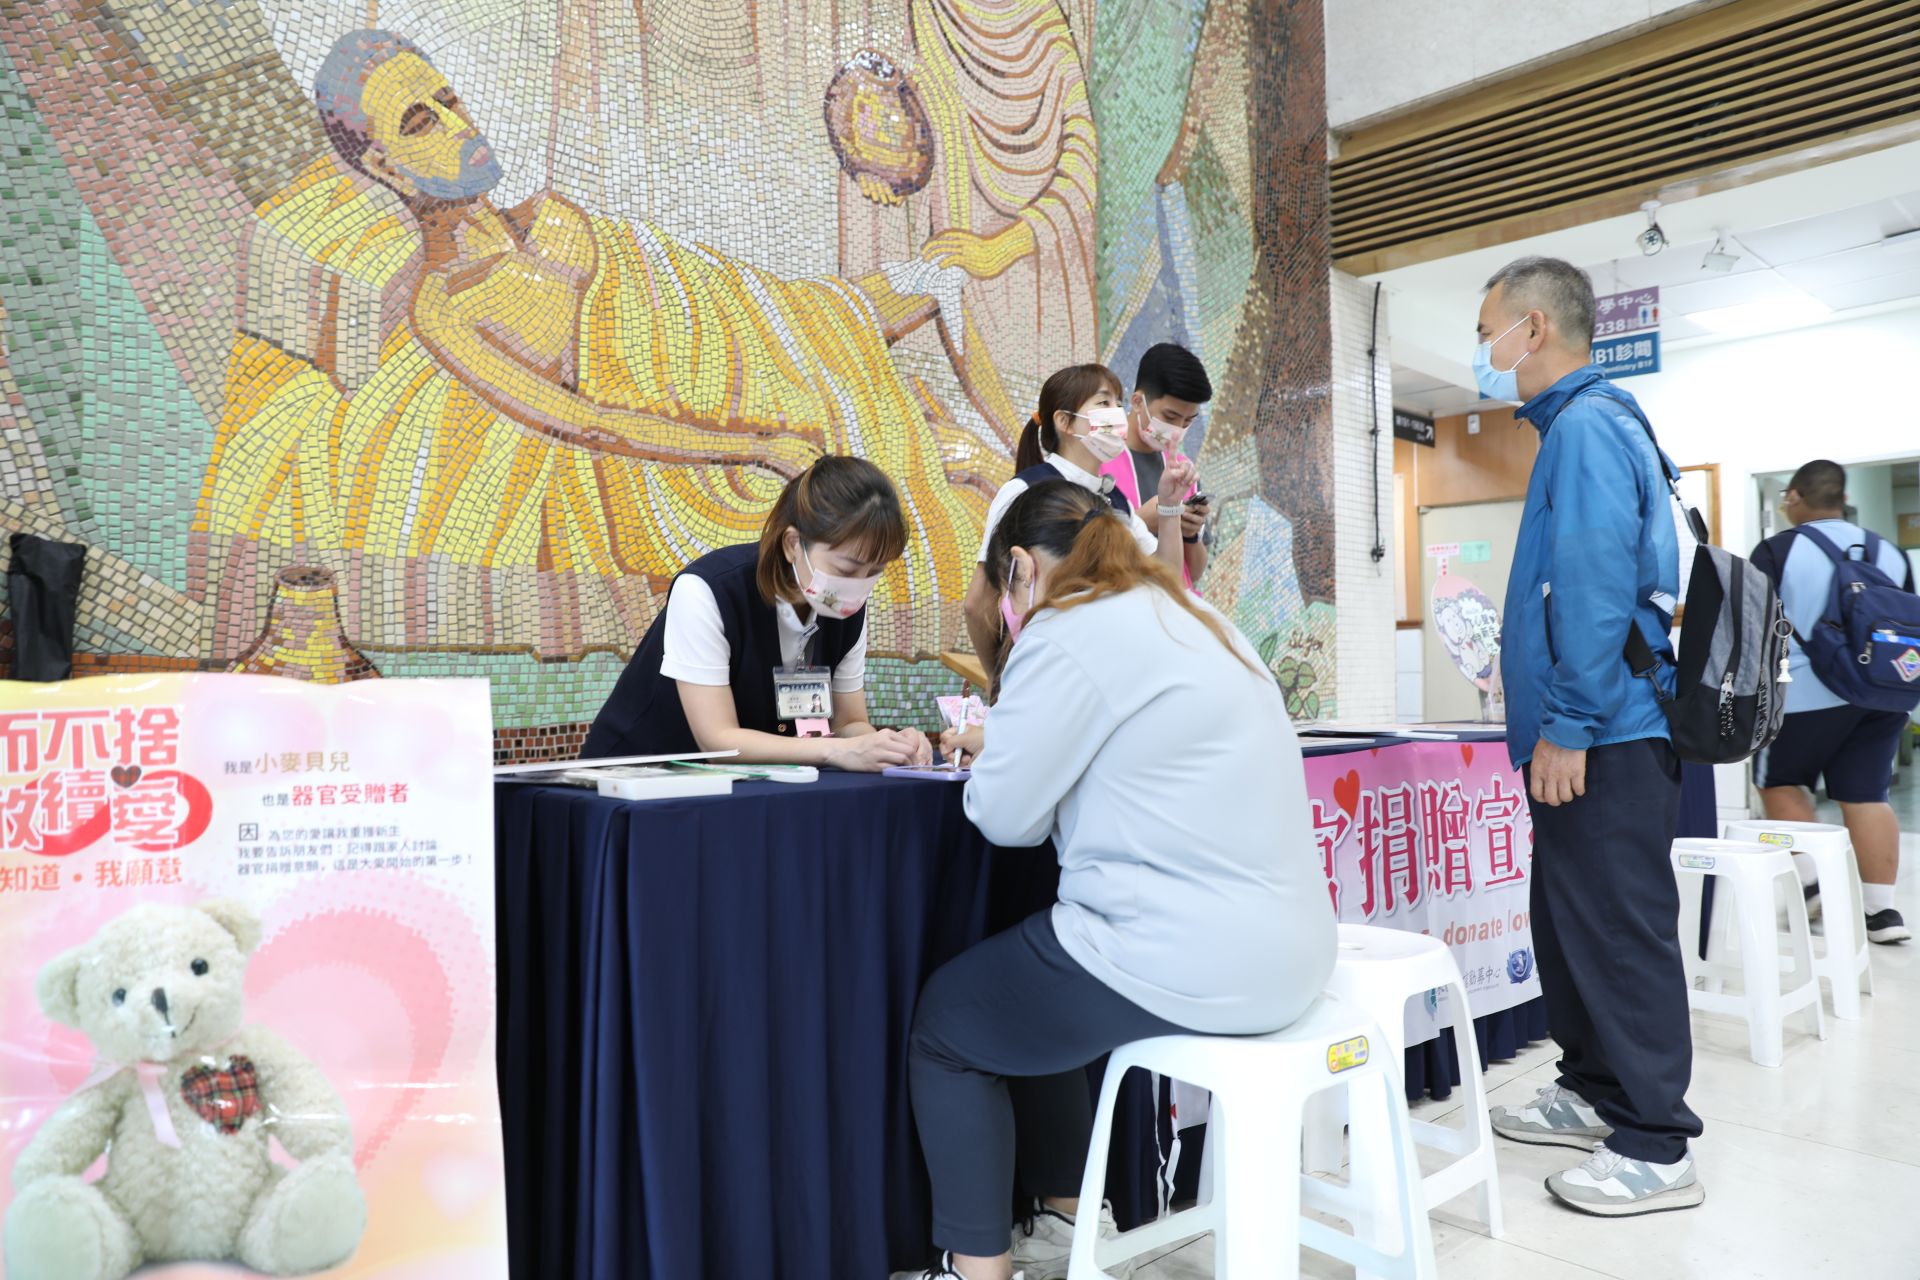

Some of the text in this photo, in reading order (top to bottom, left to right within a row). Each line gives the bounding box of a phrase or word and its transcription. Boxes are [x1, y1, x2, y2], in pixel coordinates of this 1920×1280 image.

[224, 752, 351, 775] 我是小麥貝兒
[262, 782, 408, 807] 也是器官受贈者
[1443, 917, 1503, 946] donate
